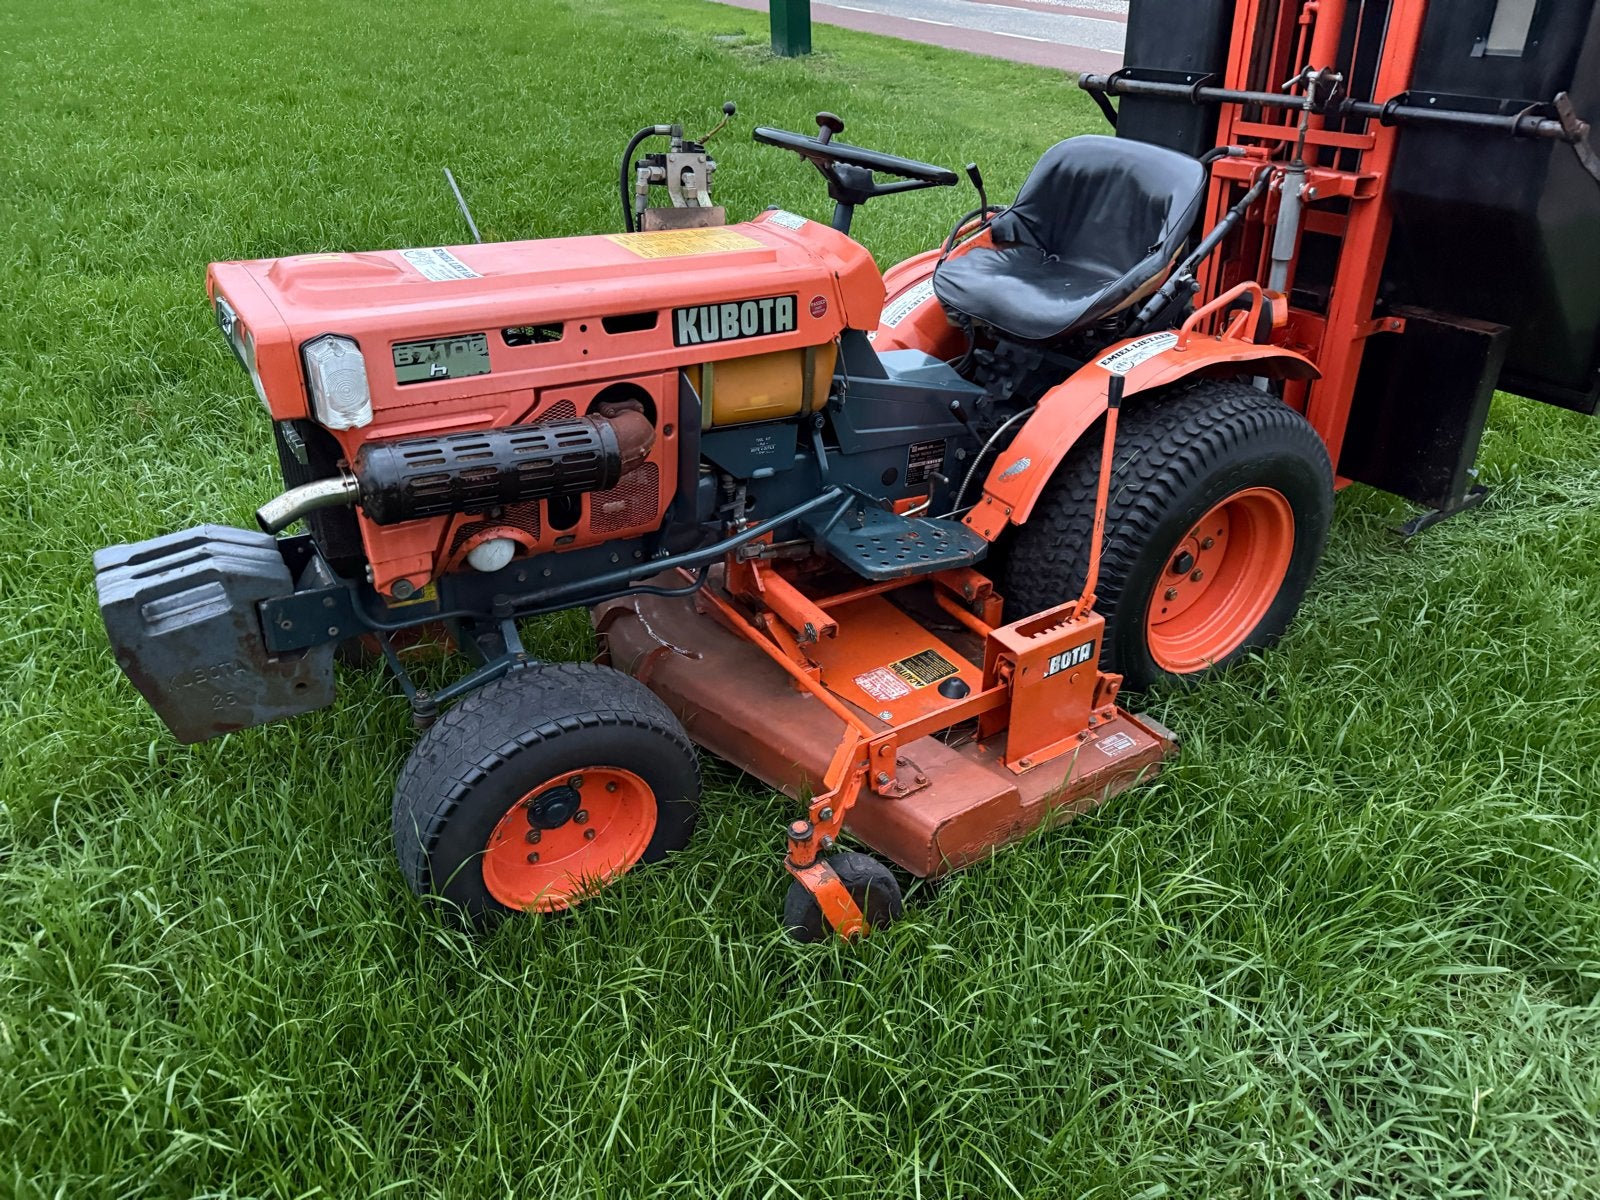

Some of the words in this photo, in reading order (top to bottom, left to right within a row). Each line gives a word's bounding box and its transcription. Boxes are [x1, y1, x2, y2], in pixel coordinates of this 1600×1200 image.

[677, 296, 793, 345] KUBOTA
[1100, 347, 1134, 366] EMIEL
[1133, 333, 1174, 348] LIETAER
[1044, 642, 1092, 677] BOTA
